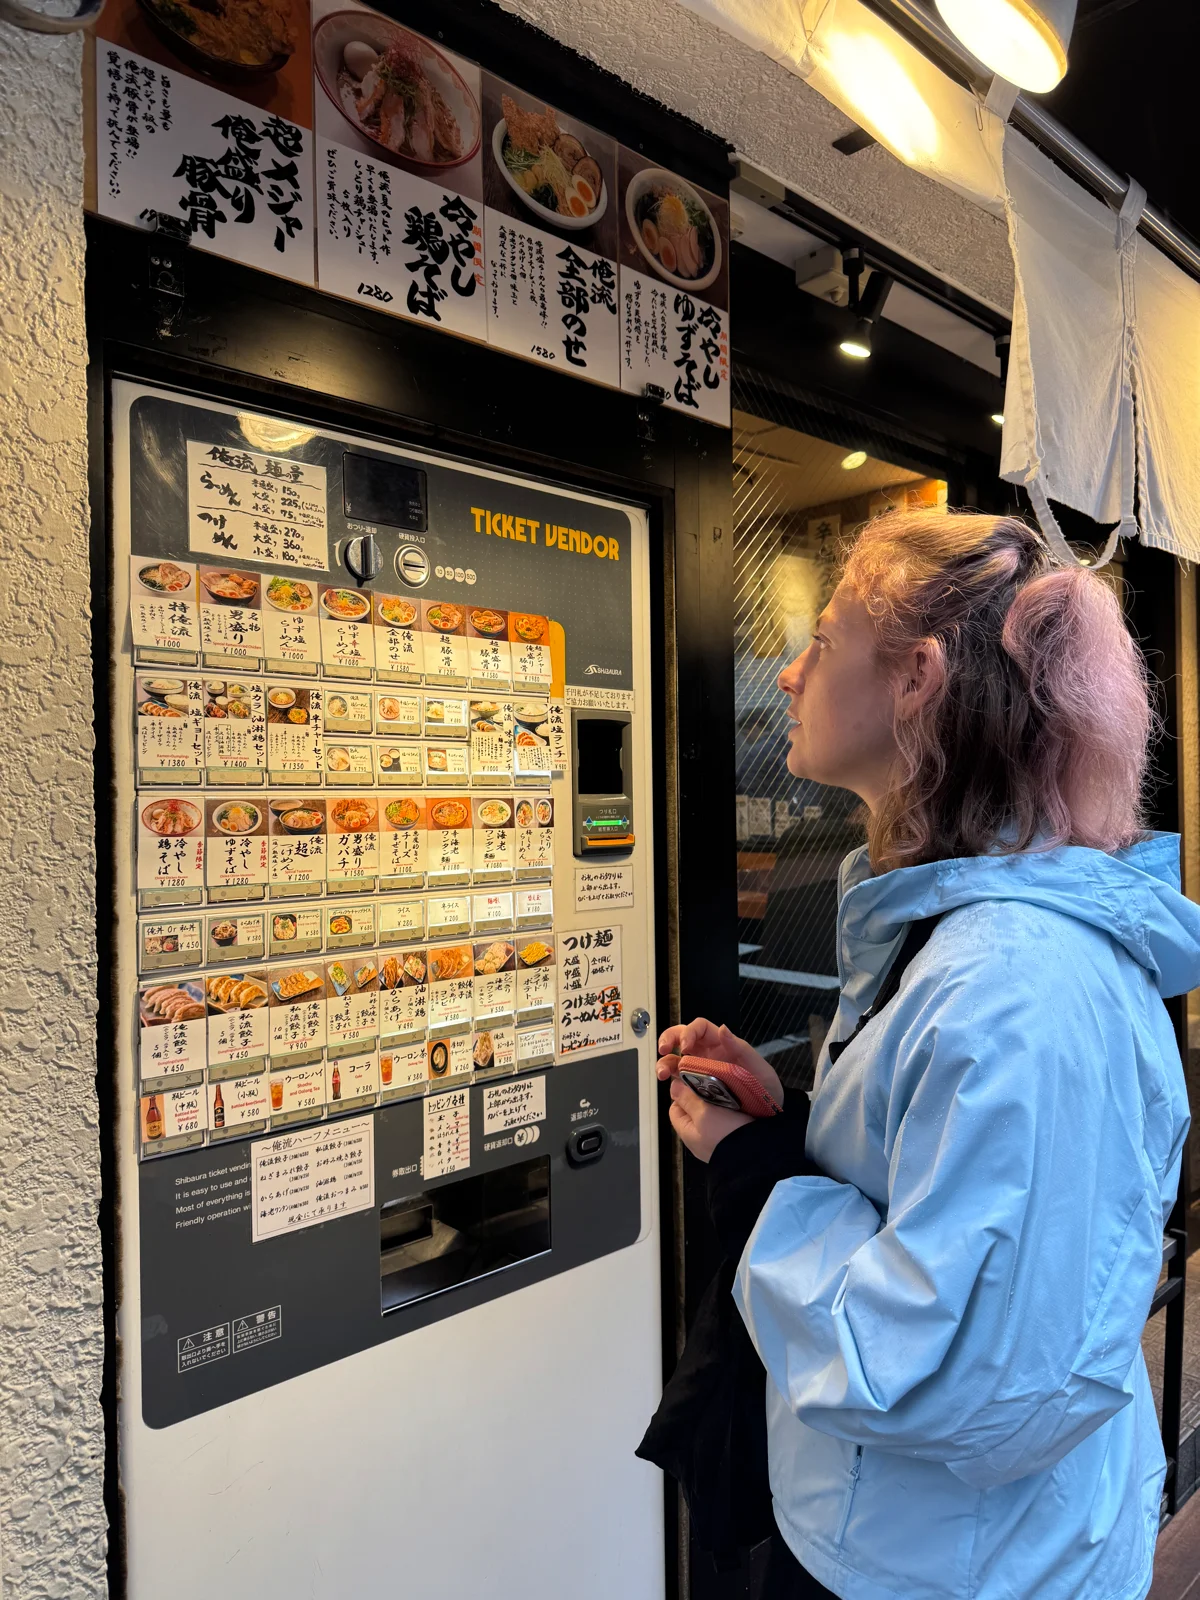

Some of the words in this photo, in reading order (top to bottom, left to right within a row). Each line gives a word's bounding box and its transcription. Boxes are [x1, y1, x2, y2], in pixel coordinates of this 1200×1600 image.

[211, 114, 264, 224] 俺盛り
[260, 115, 304, 254] 超メジャー
[172, 154, 232, 240] 豚骨
[378, 169, 393, 260] 俺流夏のヒット作
[439, 194, 478, 297] 冷やし
[402, 205, 451, 322] 鶏そば
[357, 282, 393, 303] 1280
[586, 257, 618, 316] 俺流
[555, 244, 591, 368] 全部のせ
[530, 344, 556, 361] 1580
[673, 293, 703, 410] ゆずそば
[697, 305, 722, 390] 冷やし
[262, 458, 305, 485] 麺の量
[200, 470, 242, 507] らーめん
[398, 532, 426, 544] 硬貨投入口
[470, 506, 541, 545] TICKET
[545, 526, 620, 562] VENDOR
[168, 601, 193, 638] 特俺流
[228, 608, 248, 646] 男盛り
[247, 611, 261, 633] 名物
[279, 620, 294, 649] らーめん
[292, 616, 307, 645] ゆず塩
[155, 638, 181, 649] ¥1000
[336, 627, 347, 657] らーめん
[386, 628, 401, 661] 全部のせ
[401, 630, 415, 654] 俺流
[440, 634, 453, 667] 超豚骨
[281, 651, 304, 661] ¥1000
[479, 648, 490, 669] 豚骨
[488, 640, 502, 671] 超男盛り
[519, 657, 529, 673] 豚骨
[525, 644, 536, 668] 俺盛り
[597, 669, 622, 680] SHIBAURA
[187, 681, 202, 700] 俺流
[565, 688, 635, 702] 千円札が不足しております。
[309, 692, 323, 710] 俺流
[565, 698, 632, 711] ご協力お願いいたします。
[503, 704, 514, 722] 俺流
[189, 708, 204, 766] 塩ギョーセット
[549, 705, 566, 759] 俺流塩ランチ
[293, 840, 309, 857] 超
[308, 836, 324, 855] 俺流
[364, 832, 375, 851] 俺流
[391, 832, 400, 864] まぜそば
[401, 831, 411, 858] チーズ
[496, 829, 506, 850] 海老
[157, 838, 172, 874] 鶏そば
[173, 837, 187, 873] 冷やし
[224, 839, 236, 874] ゆずそば
[239, 837, 252, 869] 冷やし
[280, 842, 294, 871] つけめん
[337, 833, 350, 869] ガバチ
[352, 832, 364, 868] 男盛り
[580, 871, 623, 883] お札のお釣りは
[397, 906, 410, 914] ライス
[146, 926, 163, 935] 俺丼
[562, 928, 614, 951] つけ麺
[179, 940, 199, 950] ¥450
[563, 955, 580, 968] 大盛
[564, 966, 581, 979] 中盛
[522, 976, 532, 1000] ポテト
[563, 978, 581, 991] 小盛
[389, 988, 402, 1021] からあげ
[414, 984, 427, 1017] 油淋鶏
[238, 1012, 253, 1047] 私流餃子
[289, 1005, 301, 1039] 私流餃子
[306, 1002, 320, 1037] 俺流餃子
[172, 1022, 188, 1055] 俺流餃子
[229, 1050, 248, 1061] ¥450
[393, 1048, 427, 1064] ウーロン茶
[163, 1063, 184, 1074] ¥450
[284, 1067, 323, 1083] ウーロンハイ
[349, 1060, 371, 1073] コーラ
[234, 1077, 260, 1089] 瓶ビール
[486, 1082, 533, 1099] お札のお釣りは
[171, 1088, 199, 1101] 瓶ビール
[428, 1093, 465, 1112] トッピング各種
[486, 1091, 533, 1110] 上部から出ます。
[486, 1104, 526, 1120] カバーを上げて
[570, 1107, 599, 1122] 返却ボタン
[177, 1122, 198, 1132] ¥680
[315, 1140, 342, 1153] 私流餃子
[483, 1136, 513, 1151] 硬貨返却口
[259, 1154, 288, 1168] 俺流餃子
[315, 1150, 363, 1167] お好み焼き餃子
[175, 1172, 206, 1185] Shibaura
[208, 1167, 228, 1177] ticket
[259, 1162, 309, 1181] ねぎまみれ餃子
[391, 1163, 417, 1178] 券取出口
[191, 1186, 209, 1195] easy
[234, 1175, 248, 1185] and
[260, 1187, 289, 1202] からあげ
[315, 1185, 357, 1202] 俺流おつまみ
[175, 1203, 195, 1214] Most
[196, 1200, 204, 1209] of
[205, 1191, 243, 1206] everything
[259, 1204, 288, 1218] 海老ワンタン
[175, 1215, 205, 1229] Friendly
[206, 1205, 242, 1220] operation
[255, 1309, 277, 1324] 警告
[203, 1327, 225, 1342] 注意
[181, 1348, 226, 1368] 入れないでください
